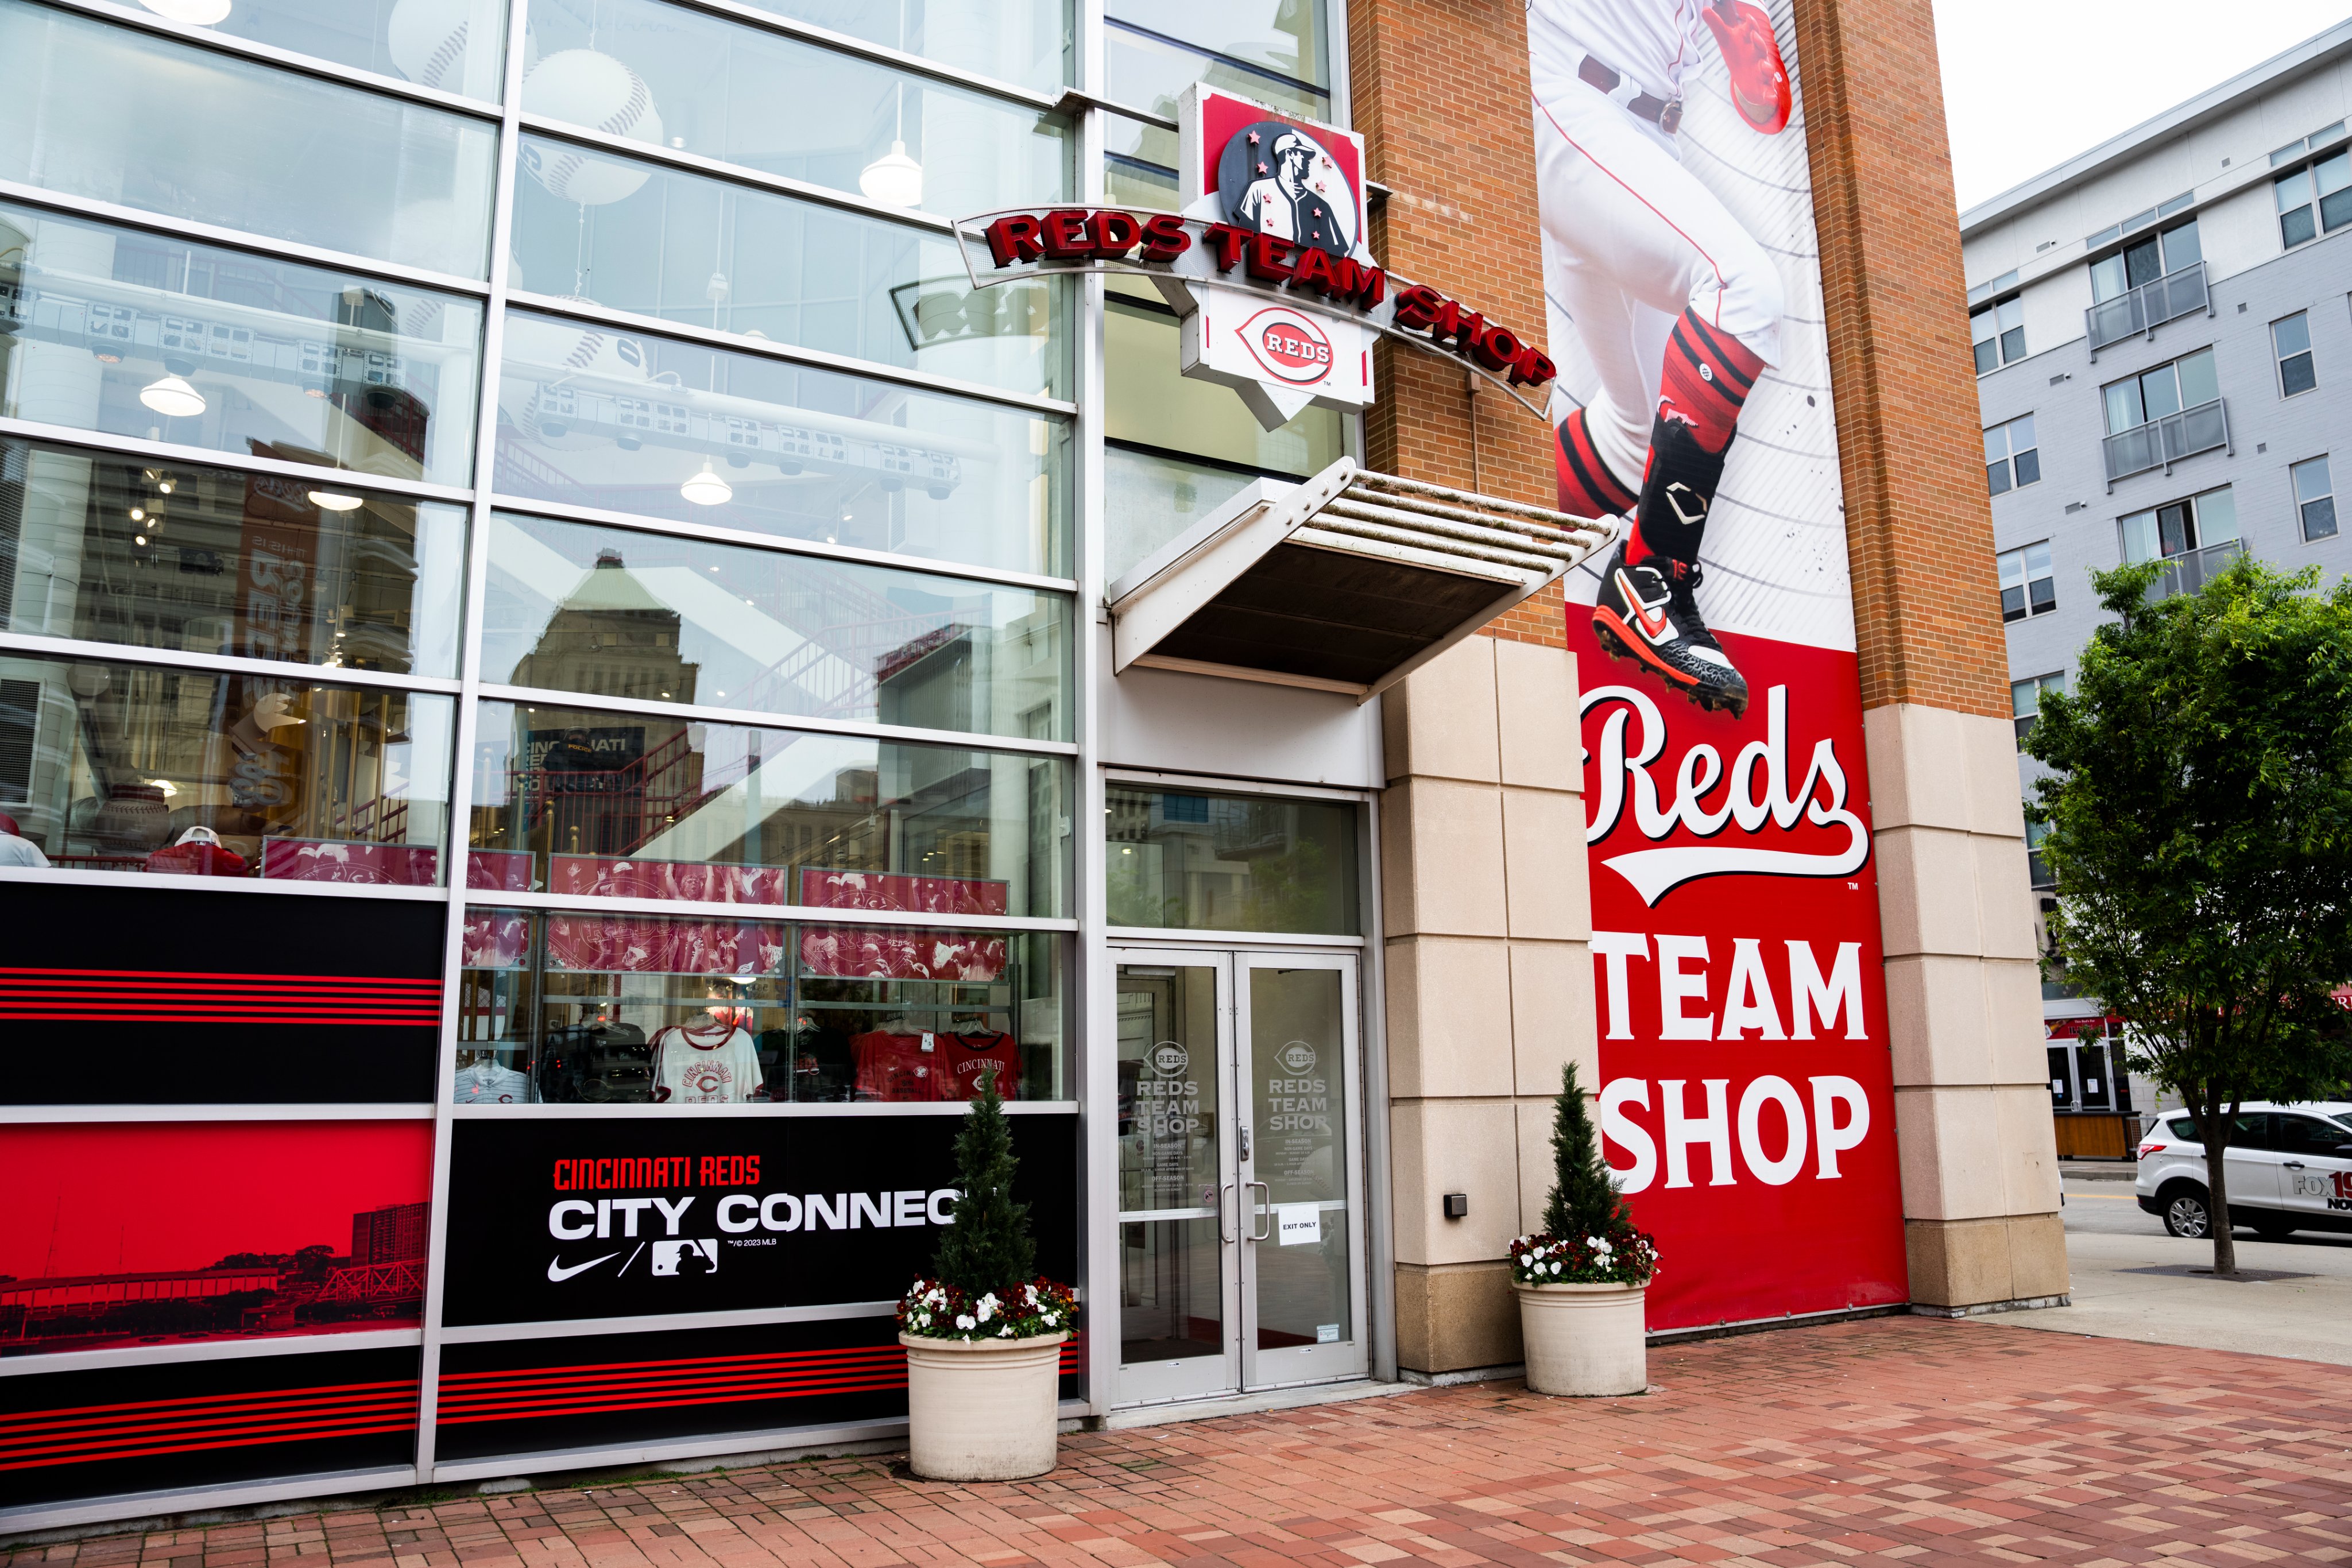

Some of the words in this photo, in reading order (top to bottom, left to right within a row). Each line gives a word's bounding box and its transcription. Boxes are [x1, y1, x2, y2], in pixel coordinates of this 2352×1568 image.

[984, 208, 1192, 269] REDS
[1203, 221, 1386, 312] TEAM
[1394, 284, 1557, 389] SHOP
[1266, 332, 1330, 363] REDS
[1579, 684, 1870, 878] Reds
[1588, 931, 1869, 1042] TEAM
[682, 1060, 732, 1088] CINCINNATI
[1136, 1081, 1198, 1096] REDS
[1269, 1079, 1326, 1093] REDS
[1136, 1099, 1199, 1115] TEAM
[1268, 1098, 1326, 1112] TEAM
[1137, 1118, 1199, 1135] SHOP
[1270, 1116, 1326, 1130] SHOP
[1599, 1075, 1870, 1194] SHOP
[554, 1157, 690, 1190] CINCINNATI
[699, 1155, 760, 1186] REDS
[548, 1197, 695, 1240] CITY
[717, 1188, 968, 1233] CONNEC
